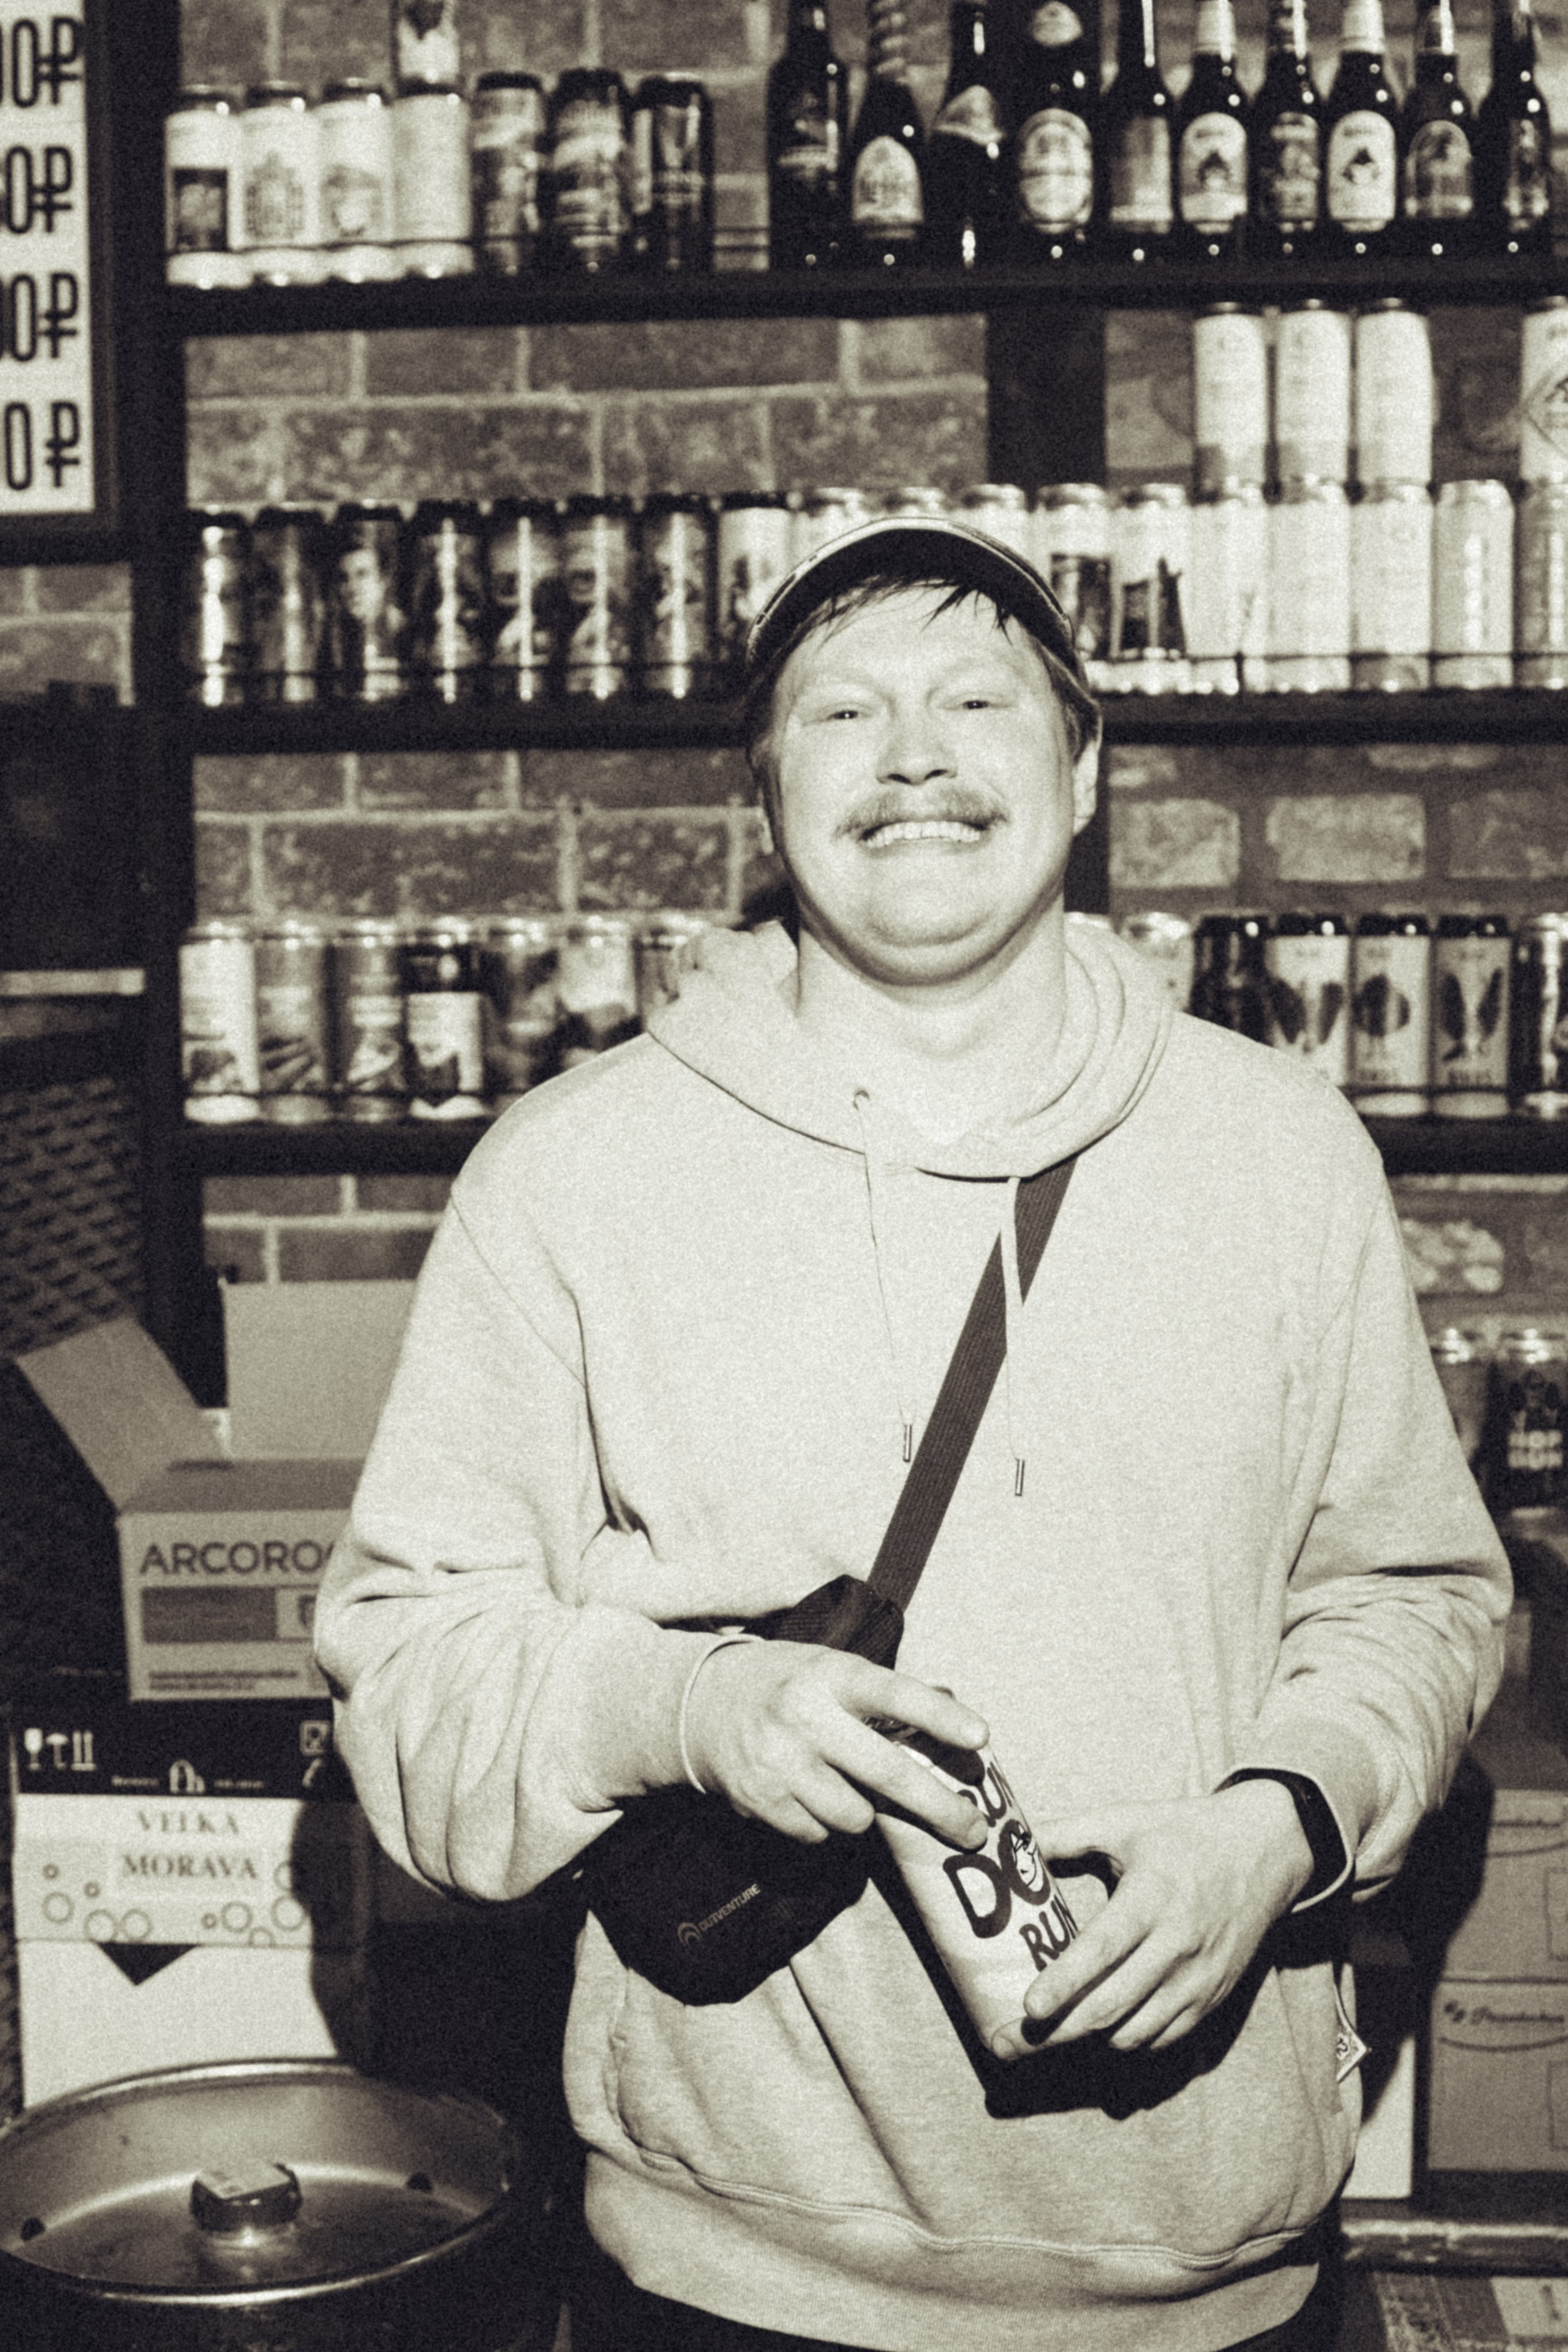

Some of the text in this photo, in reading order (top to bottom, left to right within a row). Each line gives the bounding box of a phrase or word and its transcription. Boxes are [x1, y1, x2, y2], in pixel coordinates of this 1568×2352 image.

[0, 16, 81, 108] 0₽
[0, 146, 73, 233] 0₽
[0, 273, 78, 362] 0₽
[140, 1540, 336, 1575] ARCORO
[124, 1853, 256, 1879] MORAVA
[698, 1883, 761, 1932] OUTVENTURE
[942, 1819, 1052, 1939] DO
[1019, 1887, 1079, 1972] RUN
